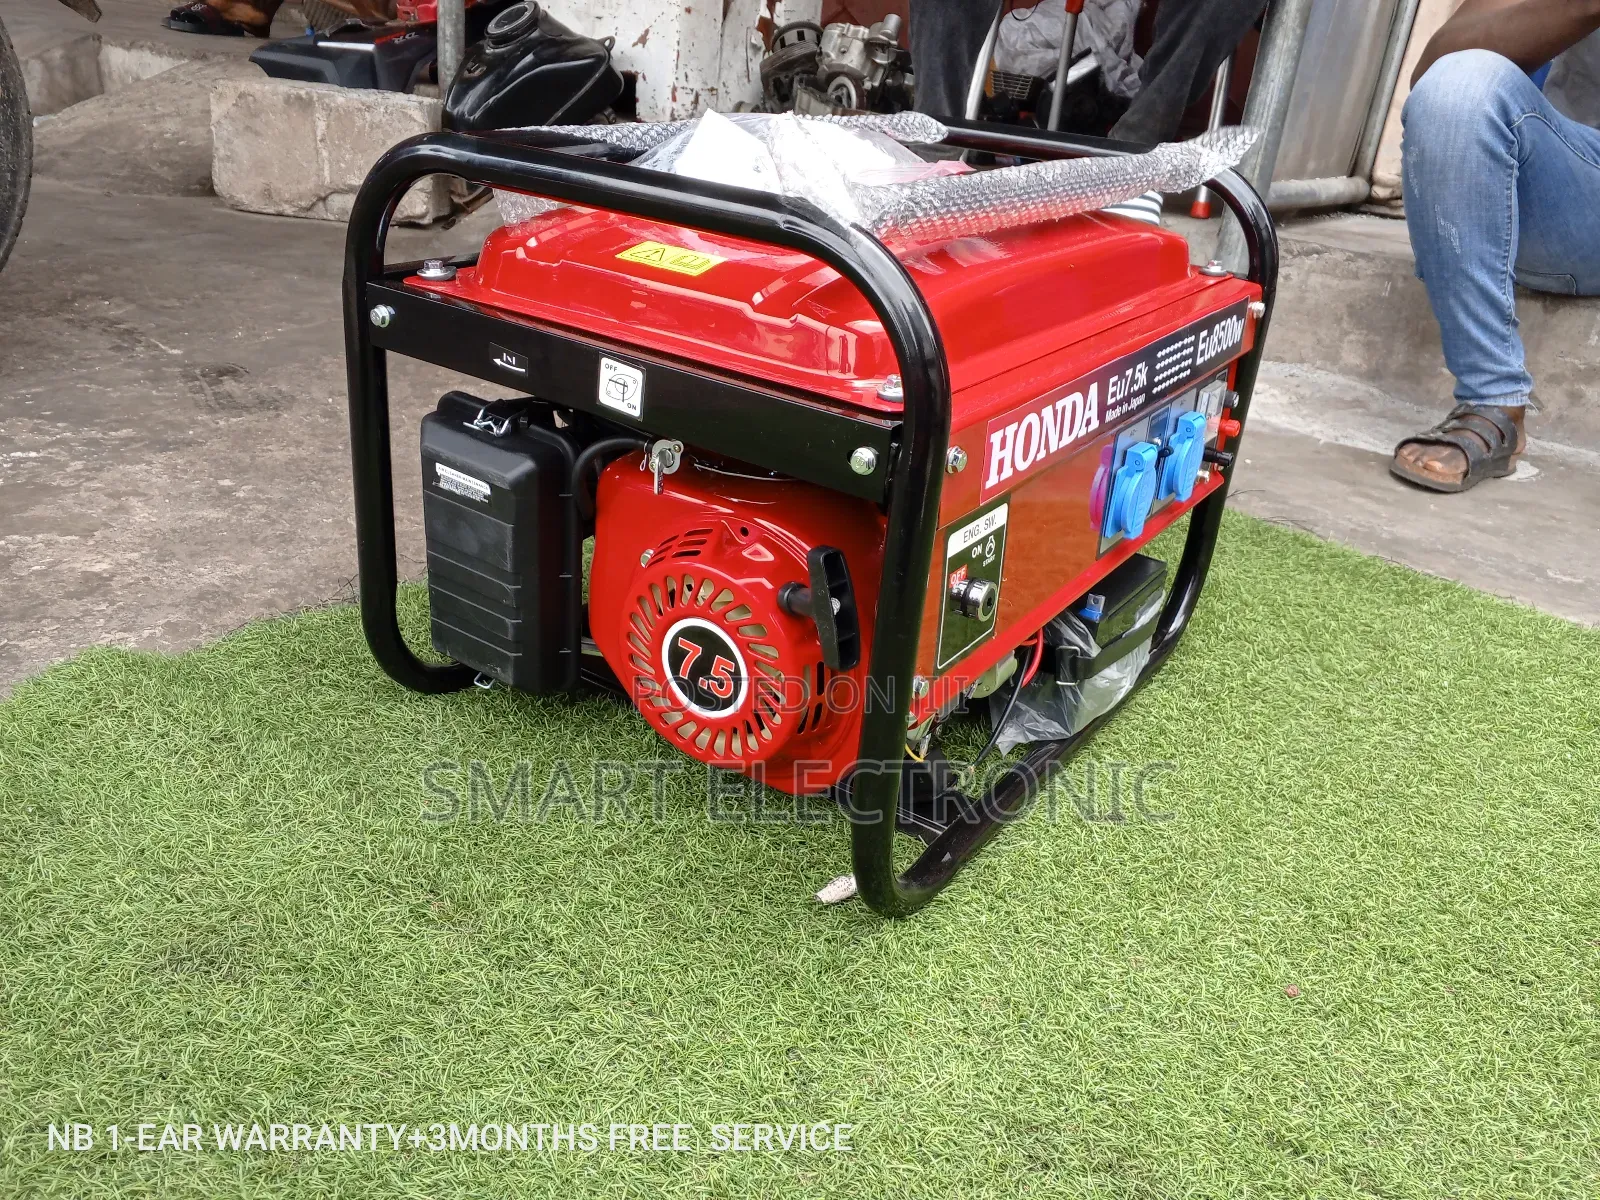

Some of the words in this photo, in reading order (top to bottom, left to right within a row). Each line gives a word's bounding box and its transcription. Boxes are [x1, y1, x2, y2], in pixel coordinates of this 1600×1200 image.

[1196, 315, 1244, 365] Eu8500w
[604, 362, 618, 373] OFF
[1106, 361, 1148, 405] Eu7.5k
[627, 402, 637, 411] ON
[1105, 405, 1122, 424] Made
[1127, 393, 1146, 412] Japan
[985, 382, 1099, 489] HONDA
[963, 523, 982, 544] ENG.
[984, 514, 997, 531] SW.
[971, 543, 983, 558] ON
[983, 554, 996, 567] START
[951, 567, 966, 583] OFF
[677, 637, 735, 699] 7.5
